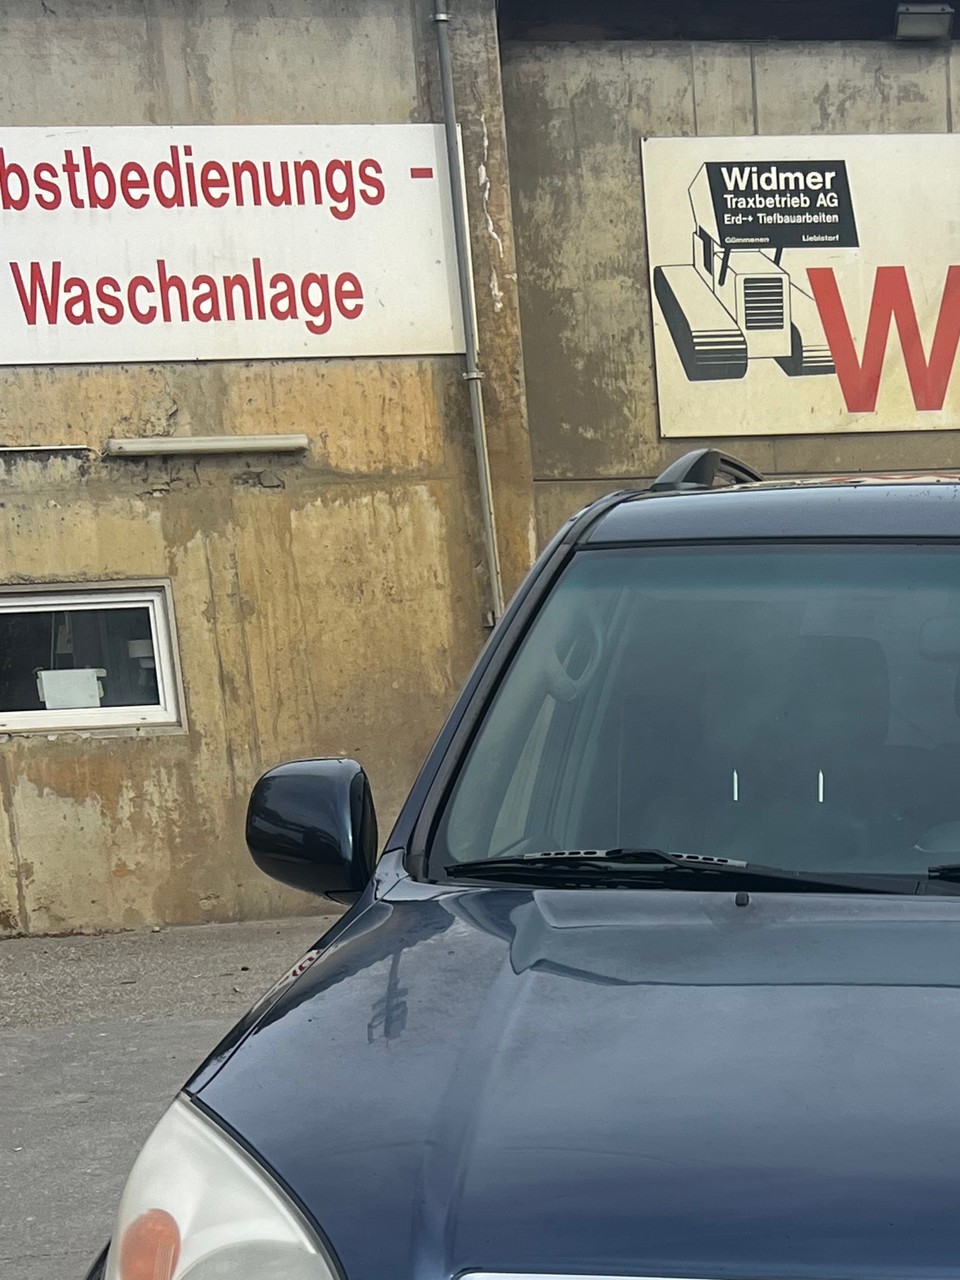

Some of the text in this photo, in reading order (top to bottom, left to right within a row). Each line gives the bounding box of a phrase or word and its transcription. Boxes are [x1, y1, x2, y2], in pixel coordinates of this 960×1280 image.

[720, 166, 836, 191] Widmer
[723, 193, 838, 209] Traxbetrieb AG
[757, 212, 839, 224] Tiefbauarbeiten
[9, 257, 364, 335] Waschanlage
